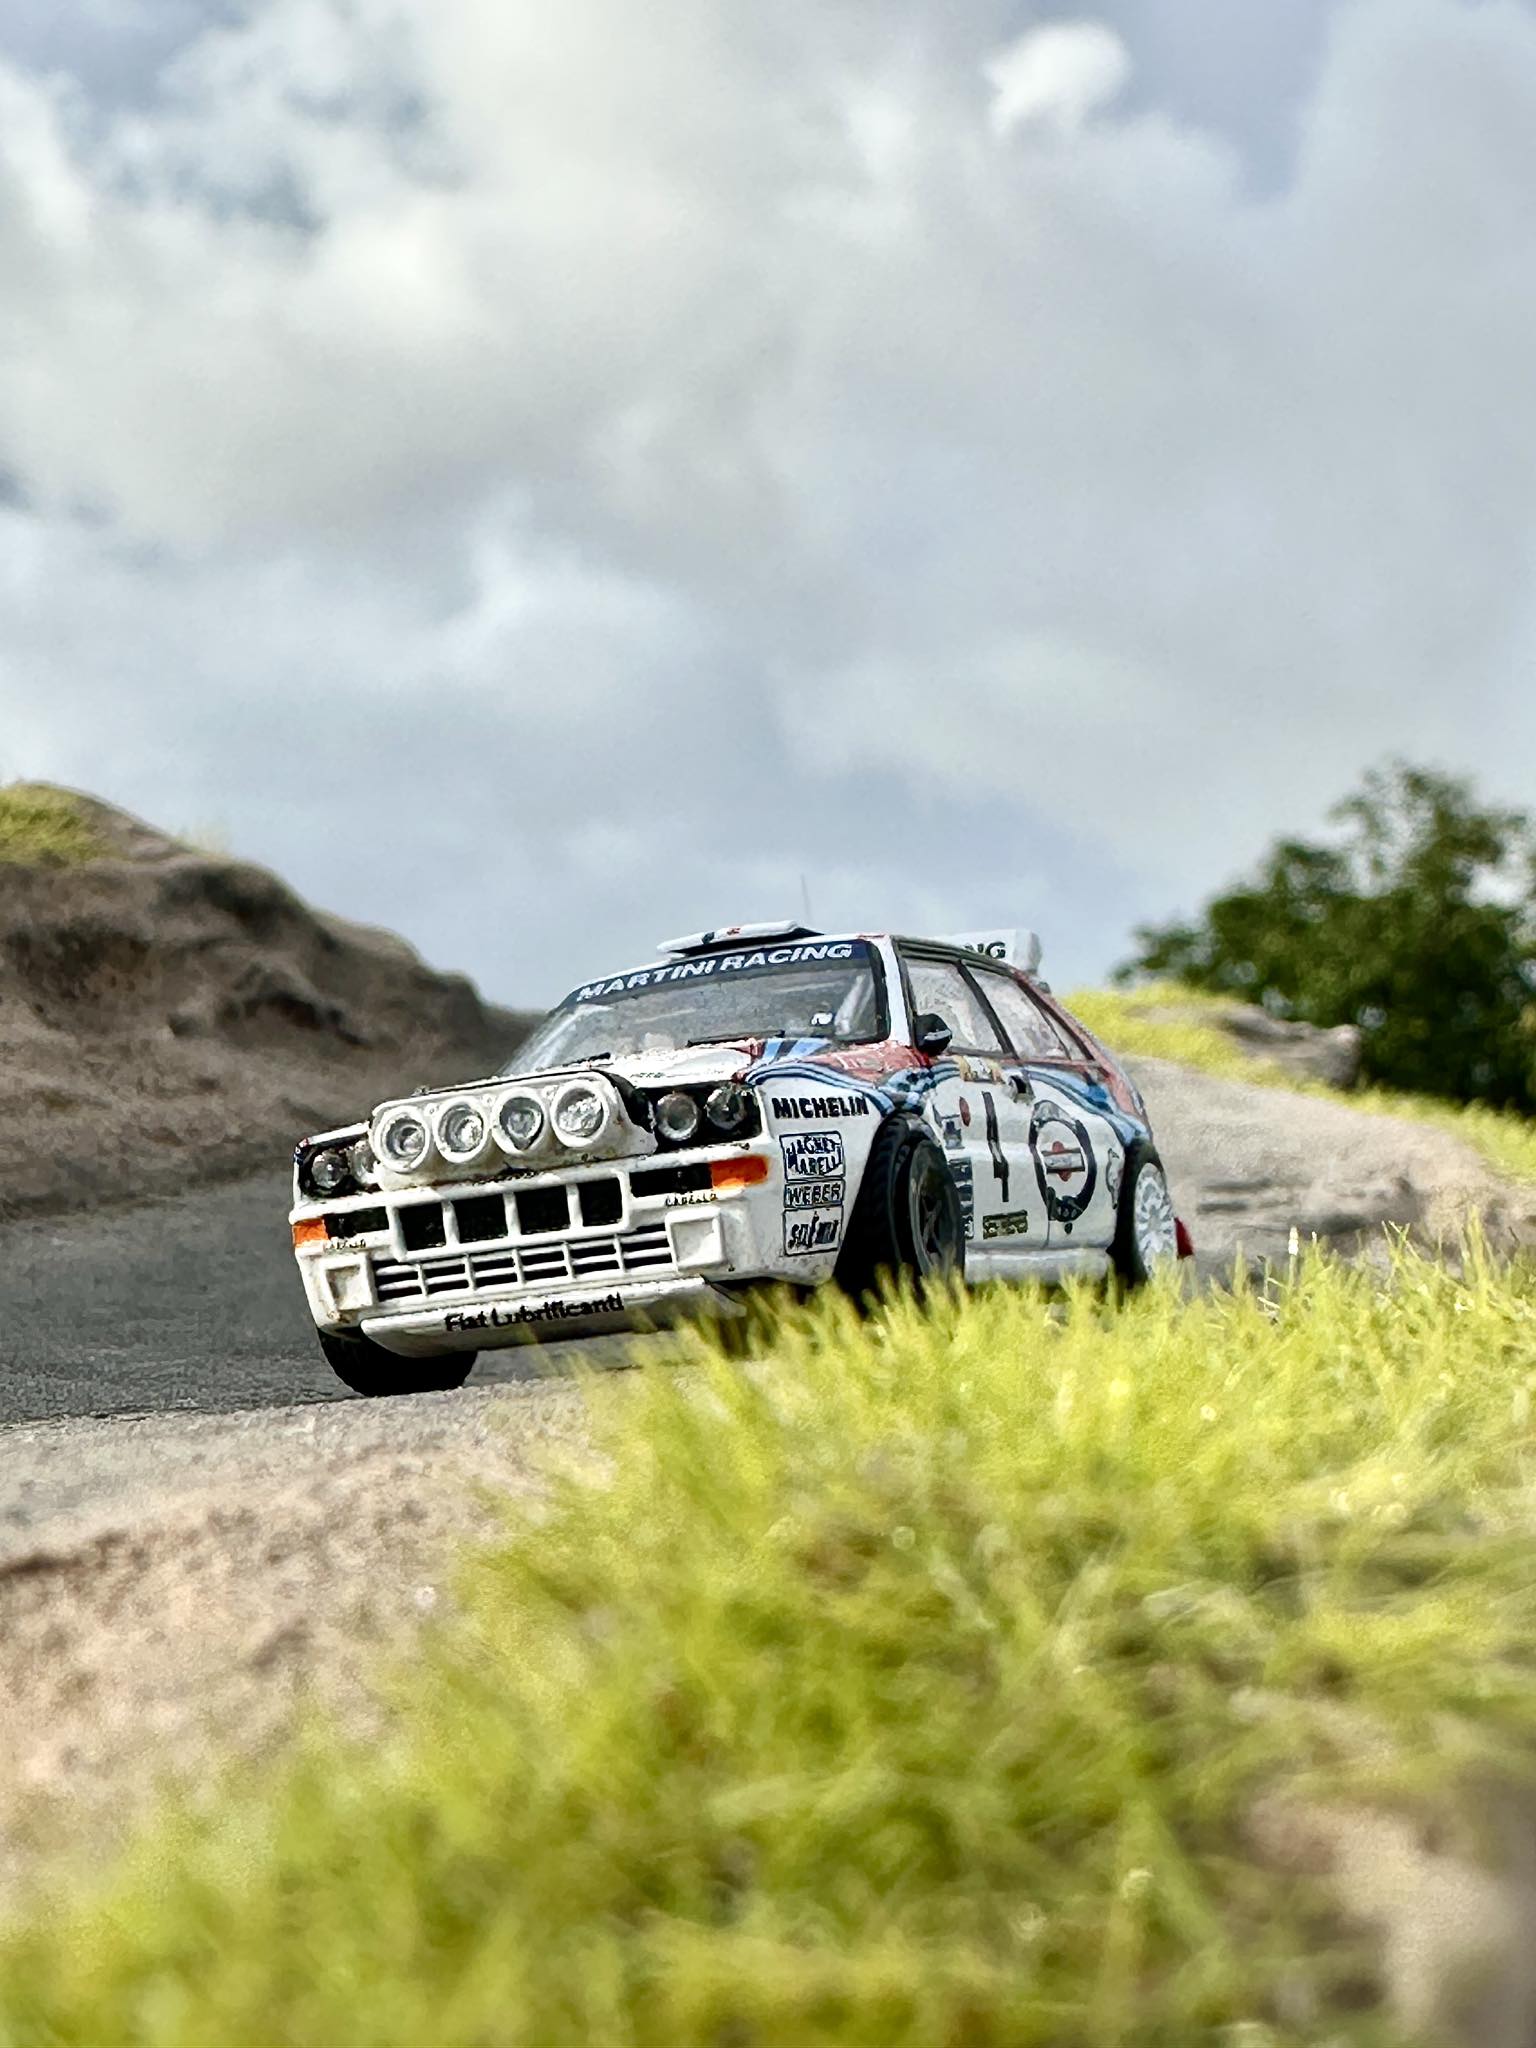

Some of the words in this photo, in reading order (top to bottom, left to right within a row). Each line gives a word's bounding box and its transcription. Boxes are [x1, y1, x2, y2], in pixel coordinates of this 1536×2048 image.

[576, 958, 717, 1002] MARTINI
[720, 943, 853, 972] RACING
[771, 1097, 870, 1119] MICHELIN
[787, 1183, 841, 1205] WEBER
[444, 1311, 489, 1332] Fiat
[491, 1291, 625, 1328] Lubrificanti
